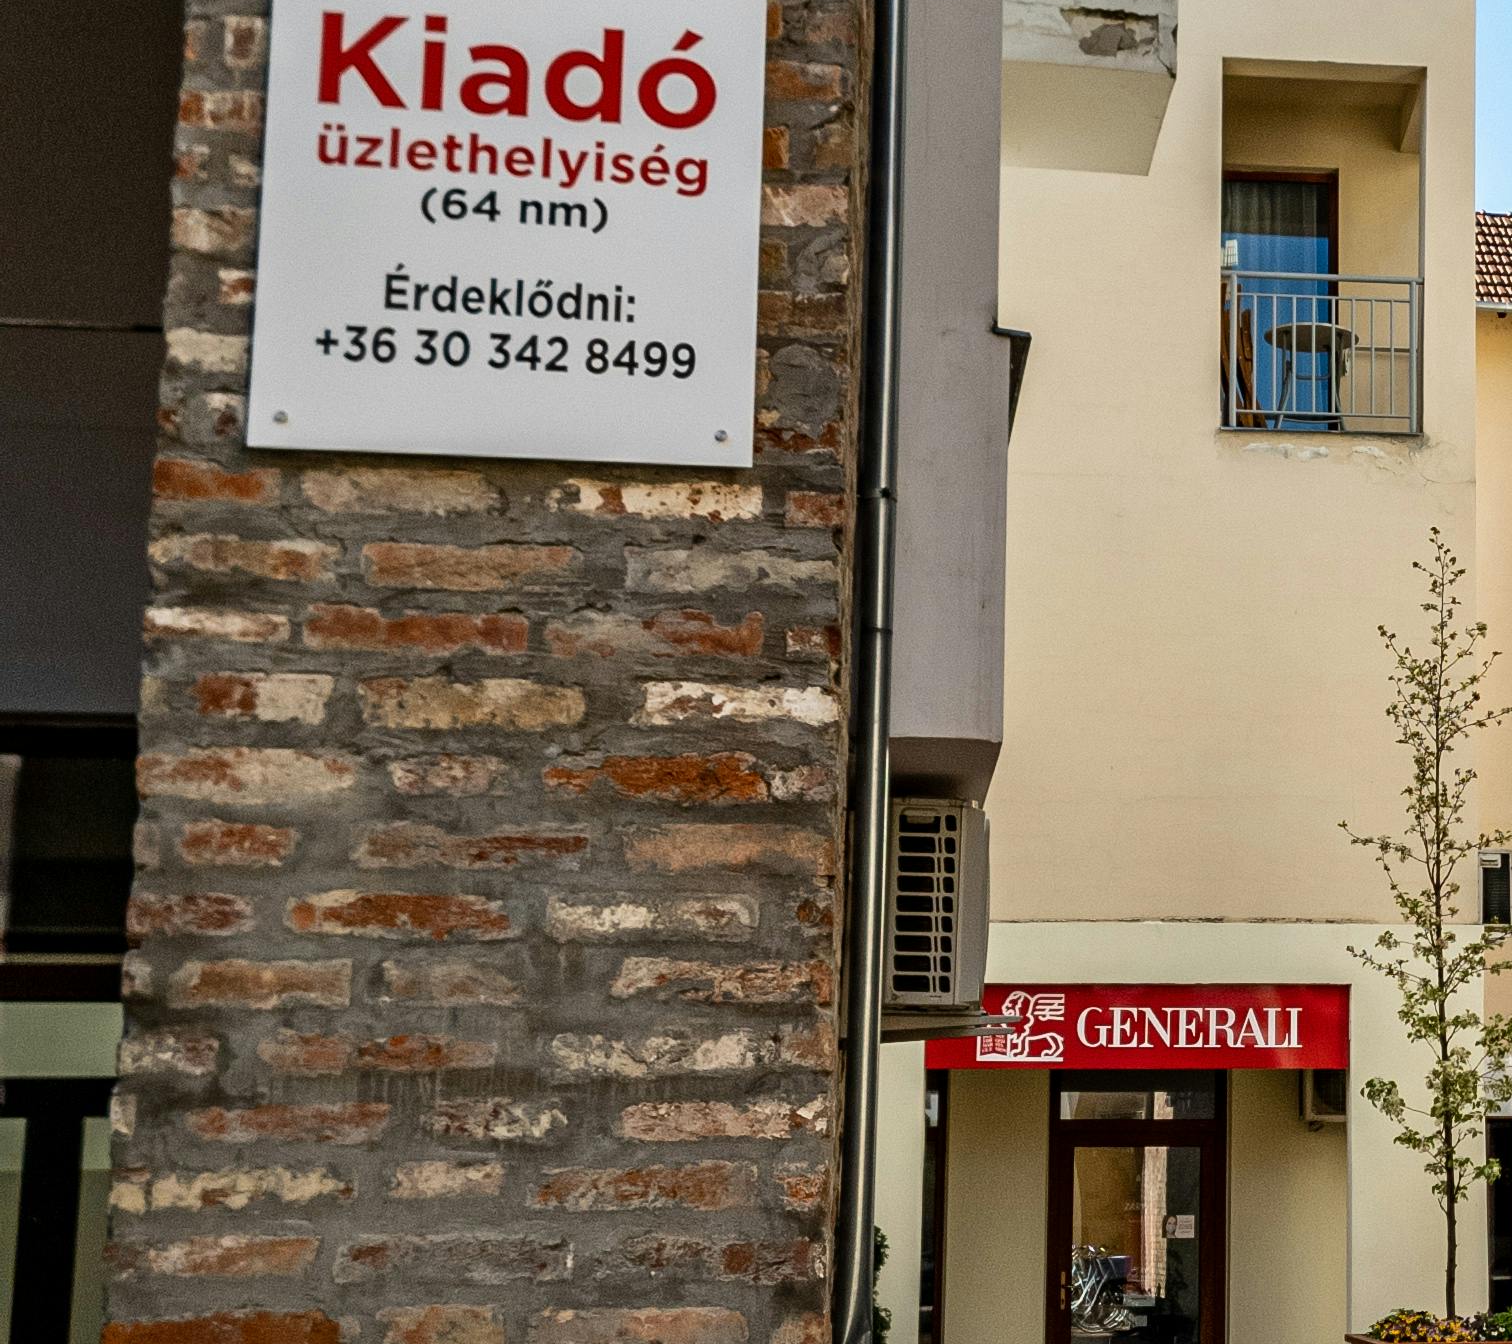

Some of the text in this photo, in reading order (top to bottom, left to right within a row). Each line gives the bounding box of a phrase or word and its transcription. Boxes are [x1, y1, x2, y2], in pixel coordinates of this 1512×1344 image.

[316, 10, 717, 131] Kiadó
[316, 122, 709, 198] üzlethelyiség
[420, 186, 609, 234] (64 nm)
[383, 262, 637, 324] Érdeklődni:
[314, 324, 697, 380] +36 30 342 8499
[1075, 1006, 1304, 1049] GENERALI
